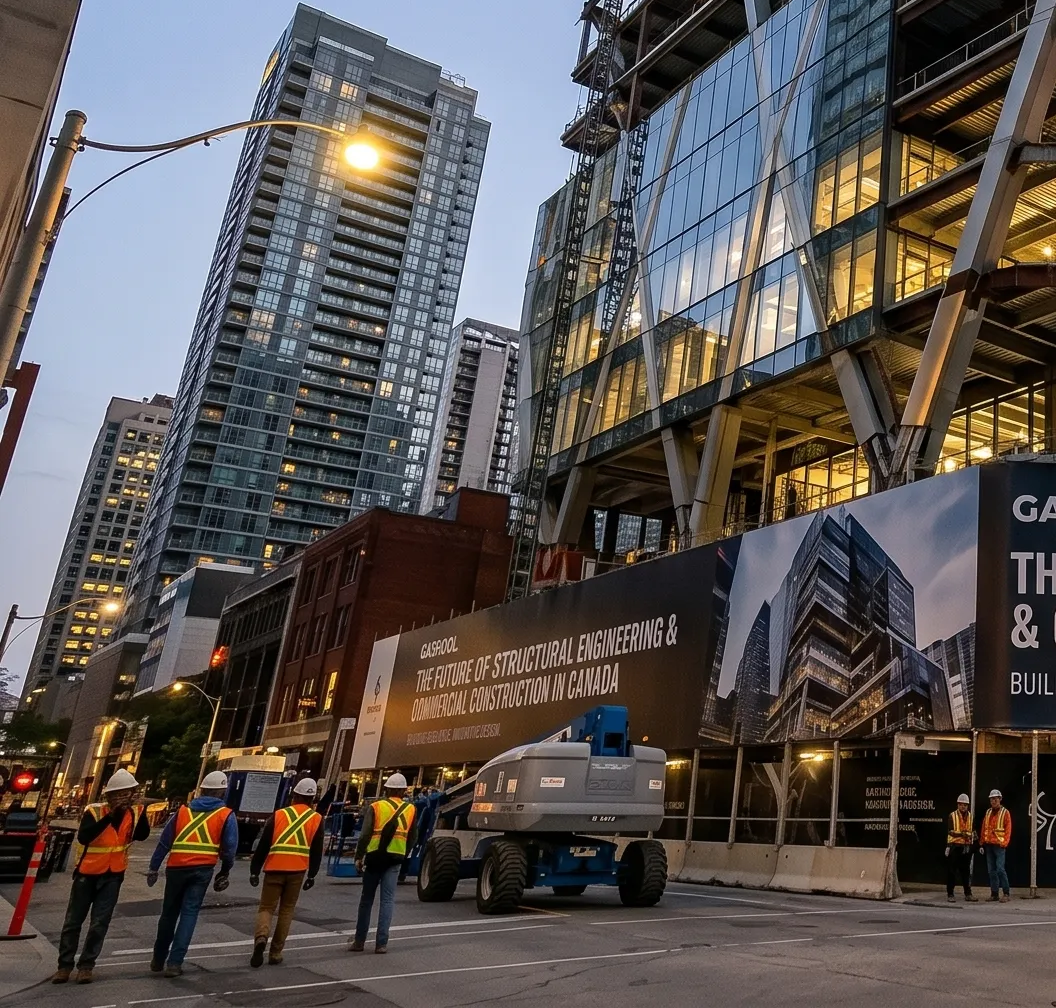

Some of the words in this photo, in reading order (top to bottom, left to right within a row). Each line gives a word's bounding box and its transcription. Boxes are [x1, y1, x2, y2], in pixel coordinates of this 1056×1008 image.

[1010, 603, 1039, 649] &
[416, 668, 435, 692] THE
[433, 658, 474, 689] FUTURE
[474, 655, 491, 682] OF
[491, 637, 575, 679] STRUCTURAL
[577, 619, 663, 663] ENGINEERING
[664, 613, 677, 645] &
[468, 674, 551, 714] CONSTRUCTION
[551, 670, 567, 702] IN
[567, 663, 620, 700] CANADA
